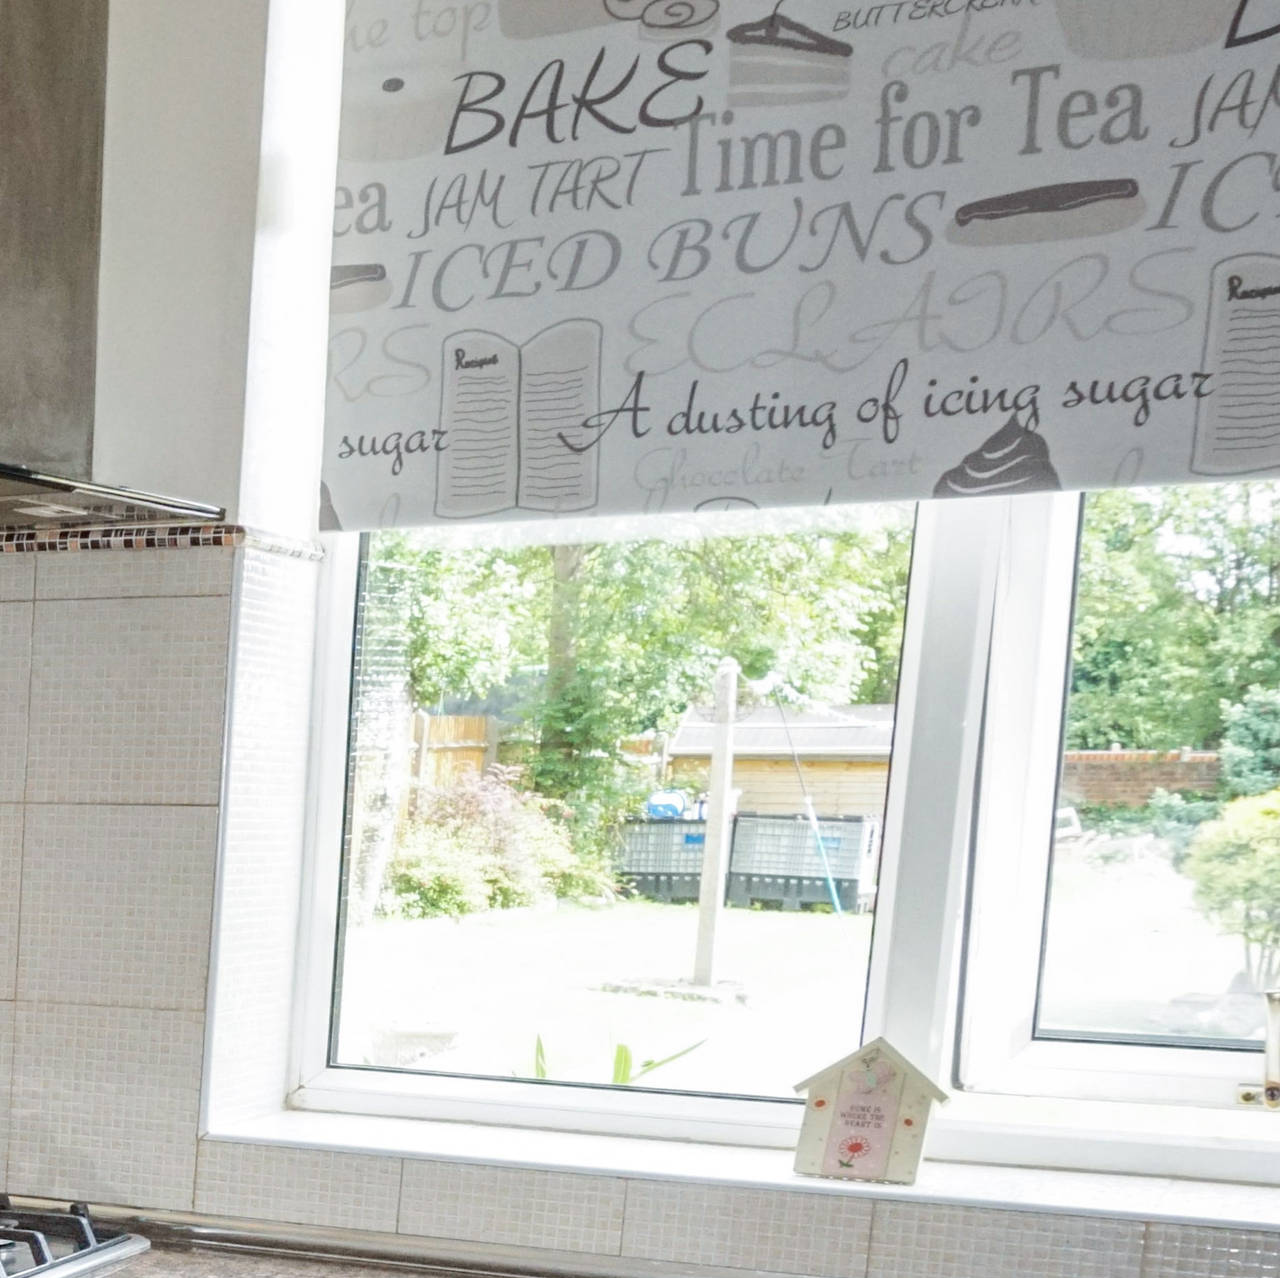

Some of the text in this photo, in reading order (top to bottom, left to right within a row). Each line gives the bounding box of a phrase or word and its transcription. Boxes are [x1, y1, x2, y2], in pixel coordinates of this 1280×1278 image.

[881, 10, 1024, 78] cake
[443, 39, 713, 156] BAKE
[673, 64, 1149, 197] Time for Tea
[406, 147, 672, 240] JAM TART
[391, 190, 947, 312] ICED BUNS
[622, 246, 1194, 378] ECLAIRS
[337, 428, 451, 477] sugar
[556, 357, 1218, 453] A dusting of icing sugar
